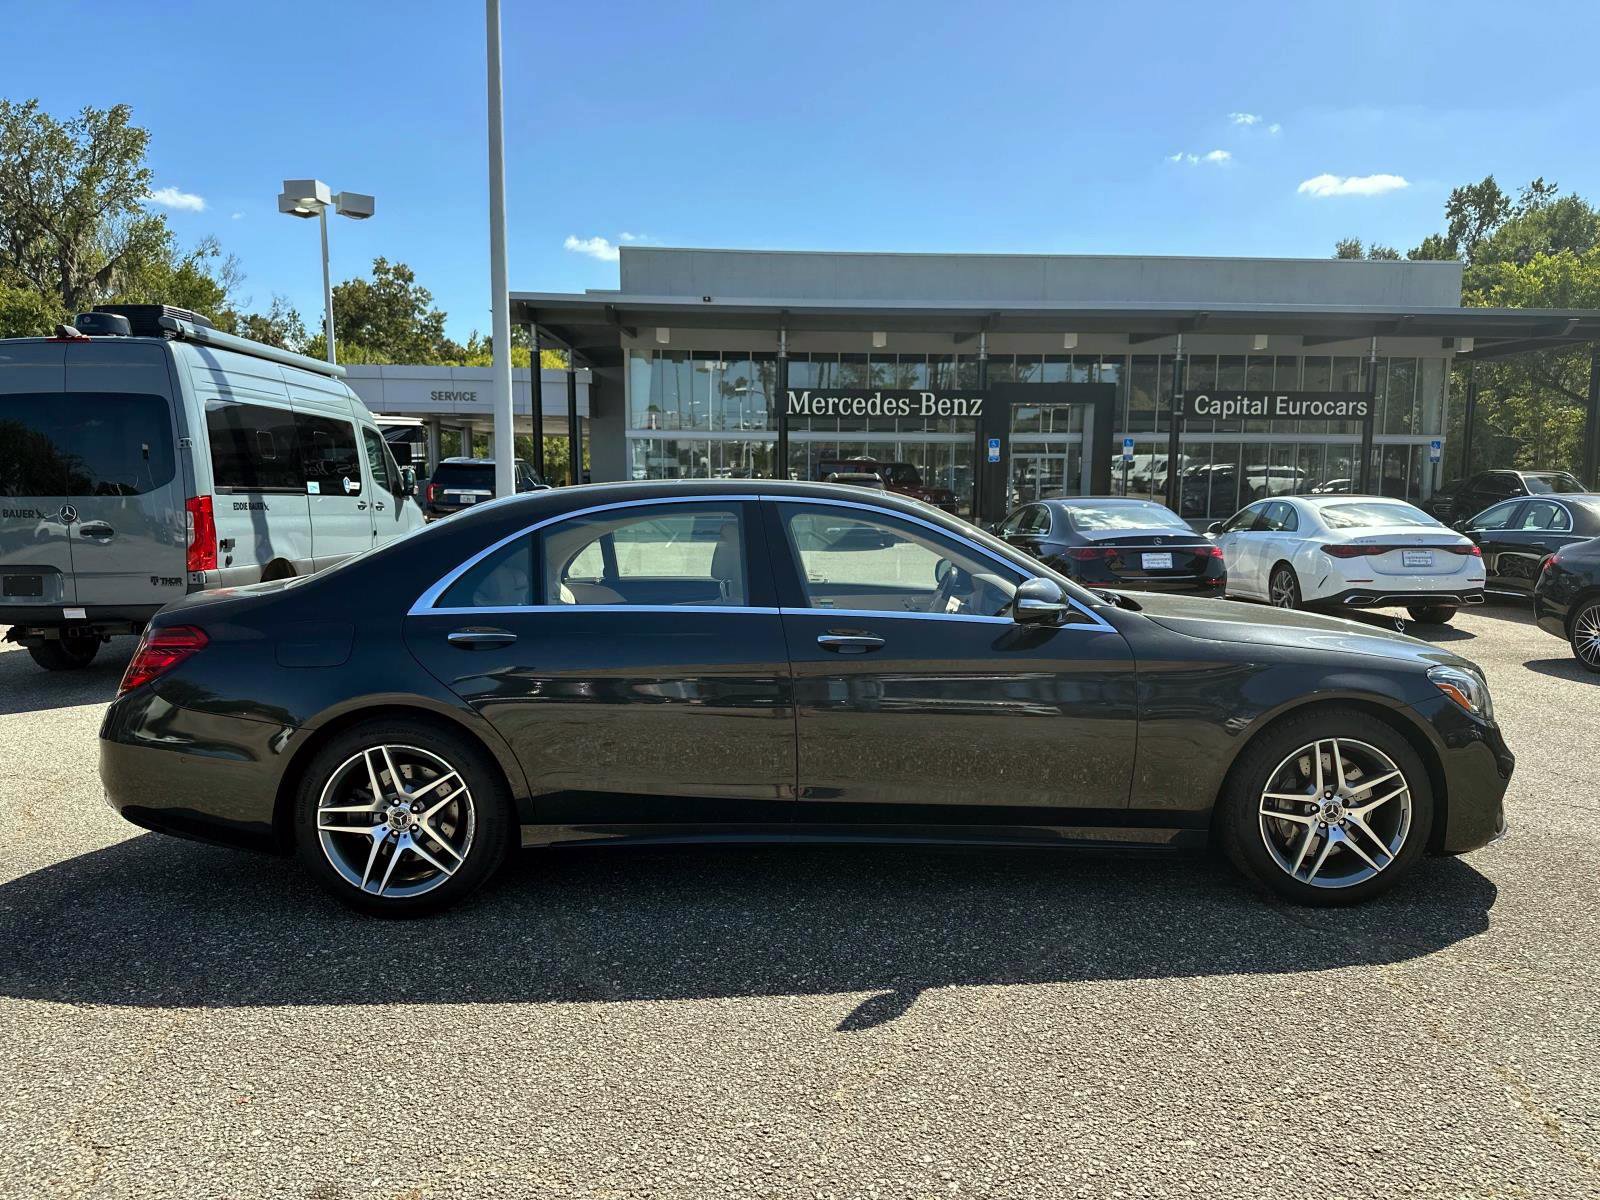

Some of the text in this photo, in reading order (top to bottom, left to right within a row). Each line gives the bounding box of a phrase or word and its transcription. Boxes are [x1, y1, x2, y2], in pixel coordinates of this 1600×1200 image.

[430, 391, 477, 401] SERVICE
[786, 391, 983, 416] Mercedes-Benz
[1194, 395, 1368, 420] Capital Eurocars
[2, 509, 34, 519] BAUER
